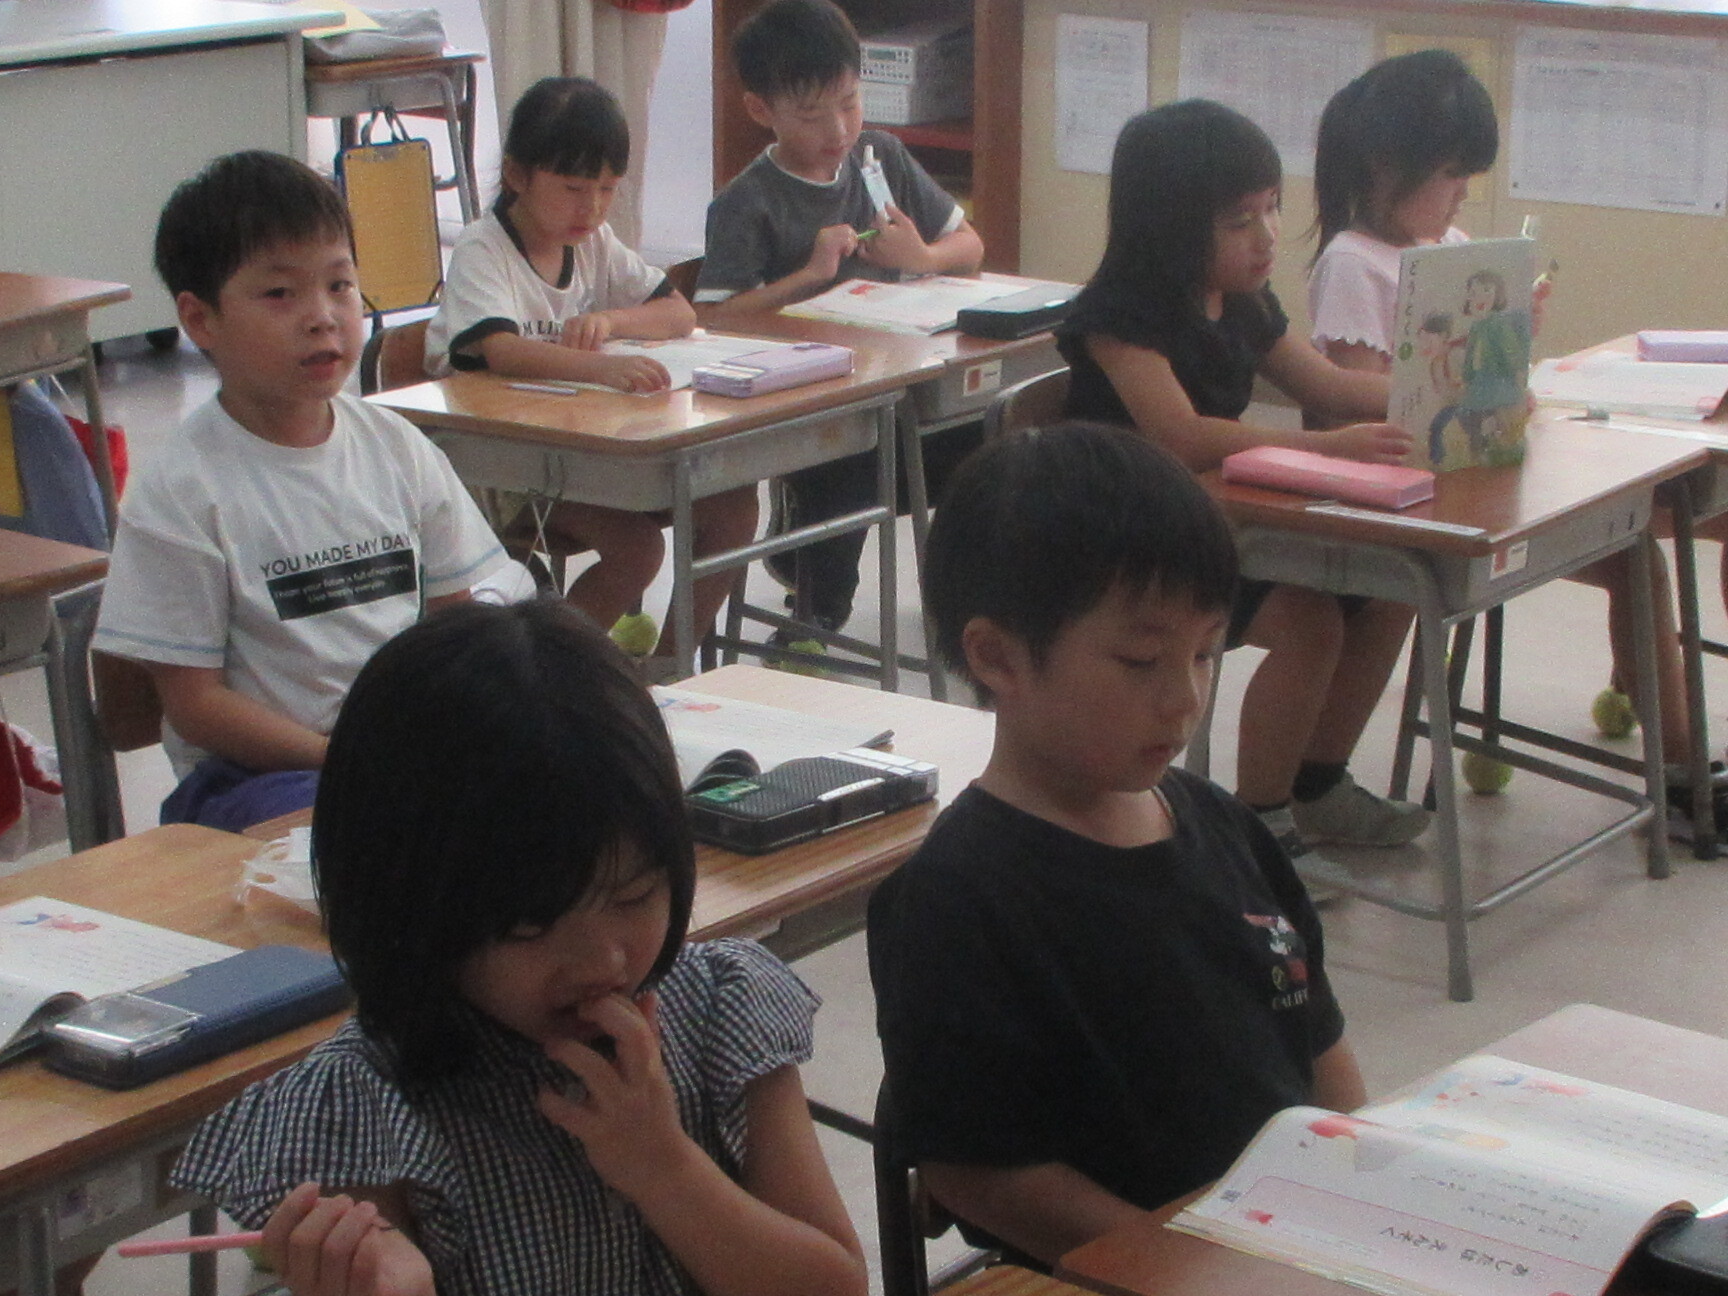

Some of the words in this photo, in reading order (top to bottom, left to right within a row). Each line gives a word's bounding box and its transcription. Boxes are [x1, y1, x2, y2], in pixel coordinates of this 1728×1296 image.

[259, 556, 301, 578] YOU
[305, 544, 354, 569] MADE
[356, 537, 378, 557] MY
